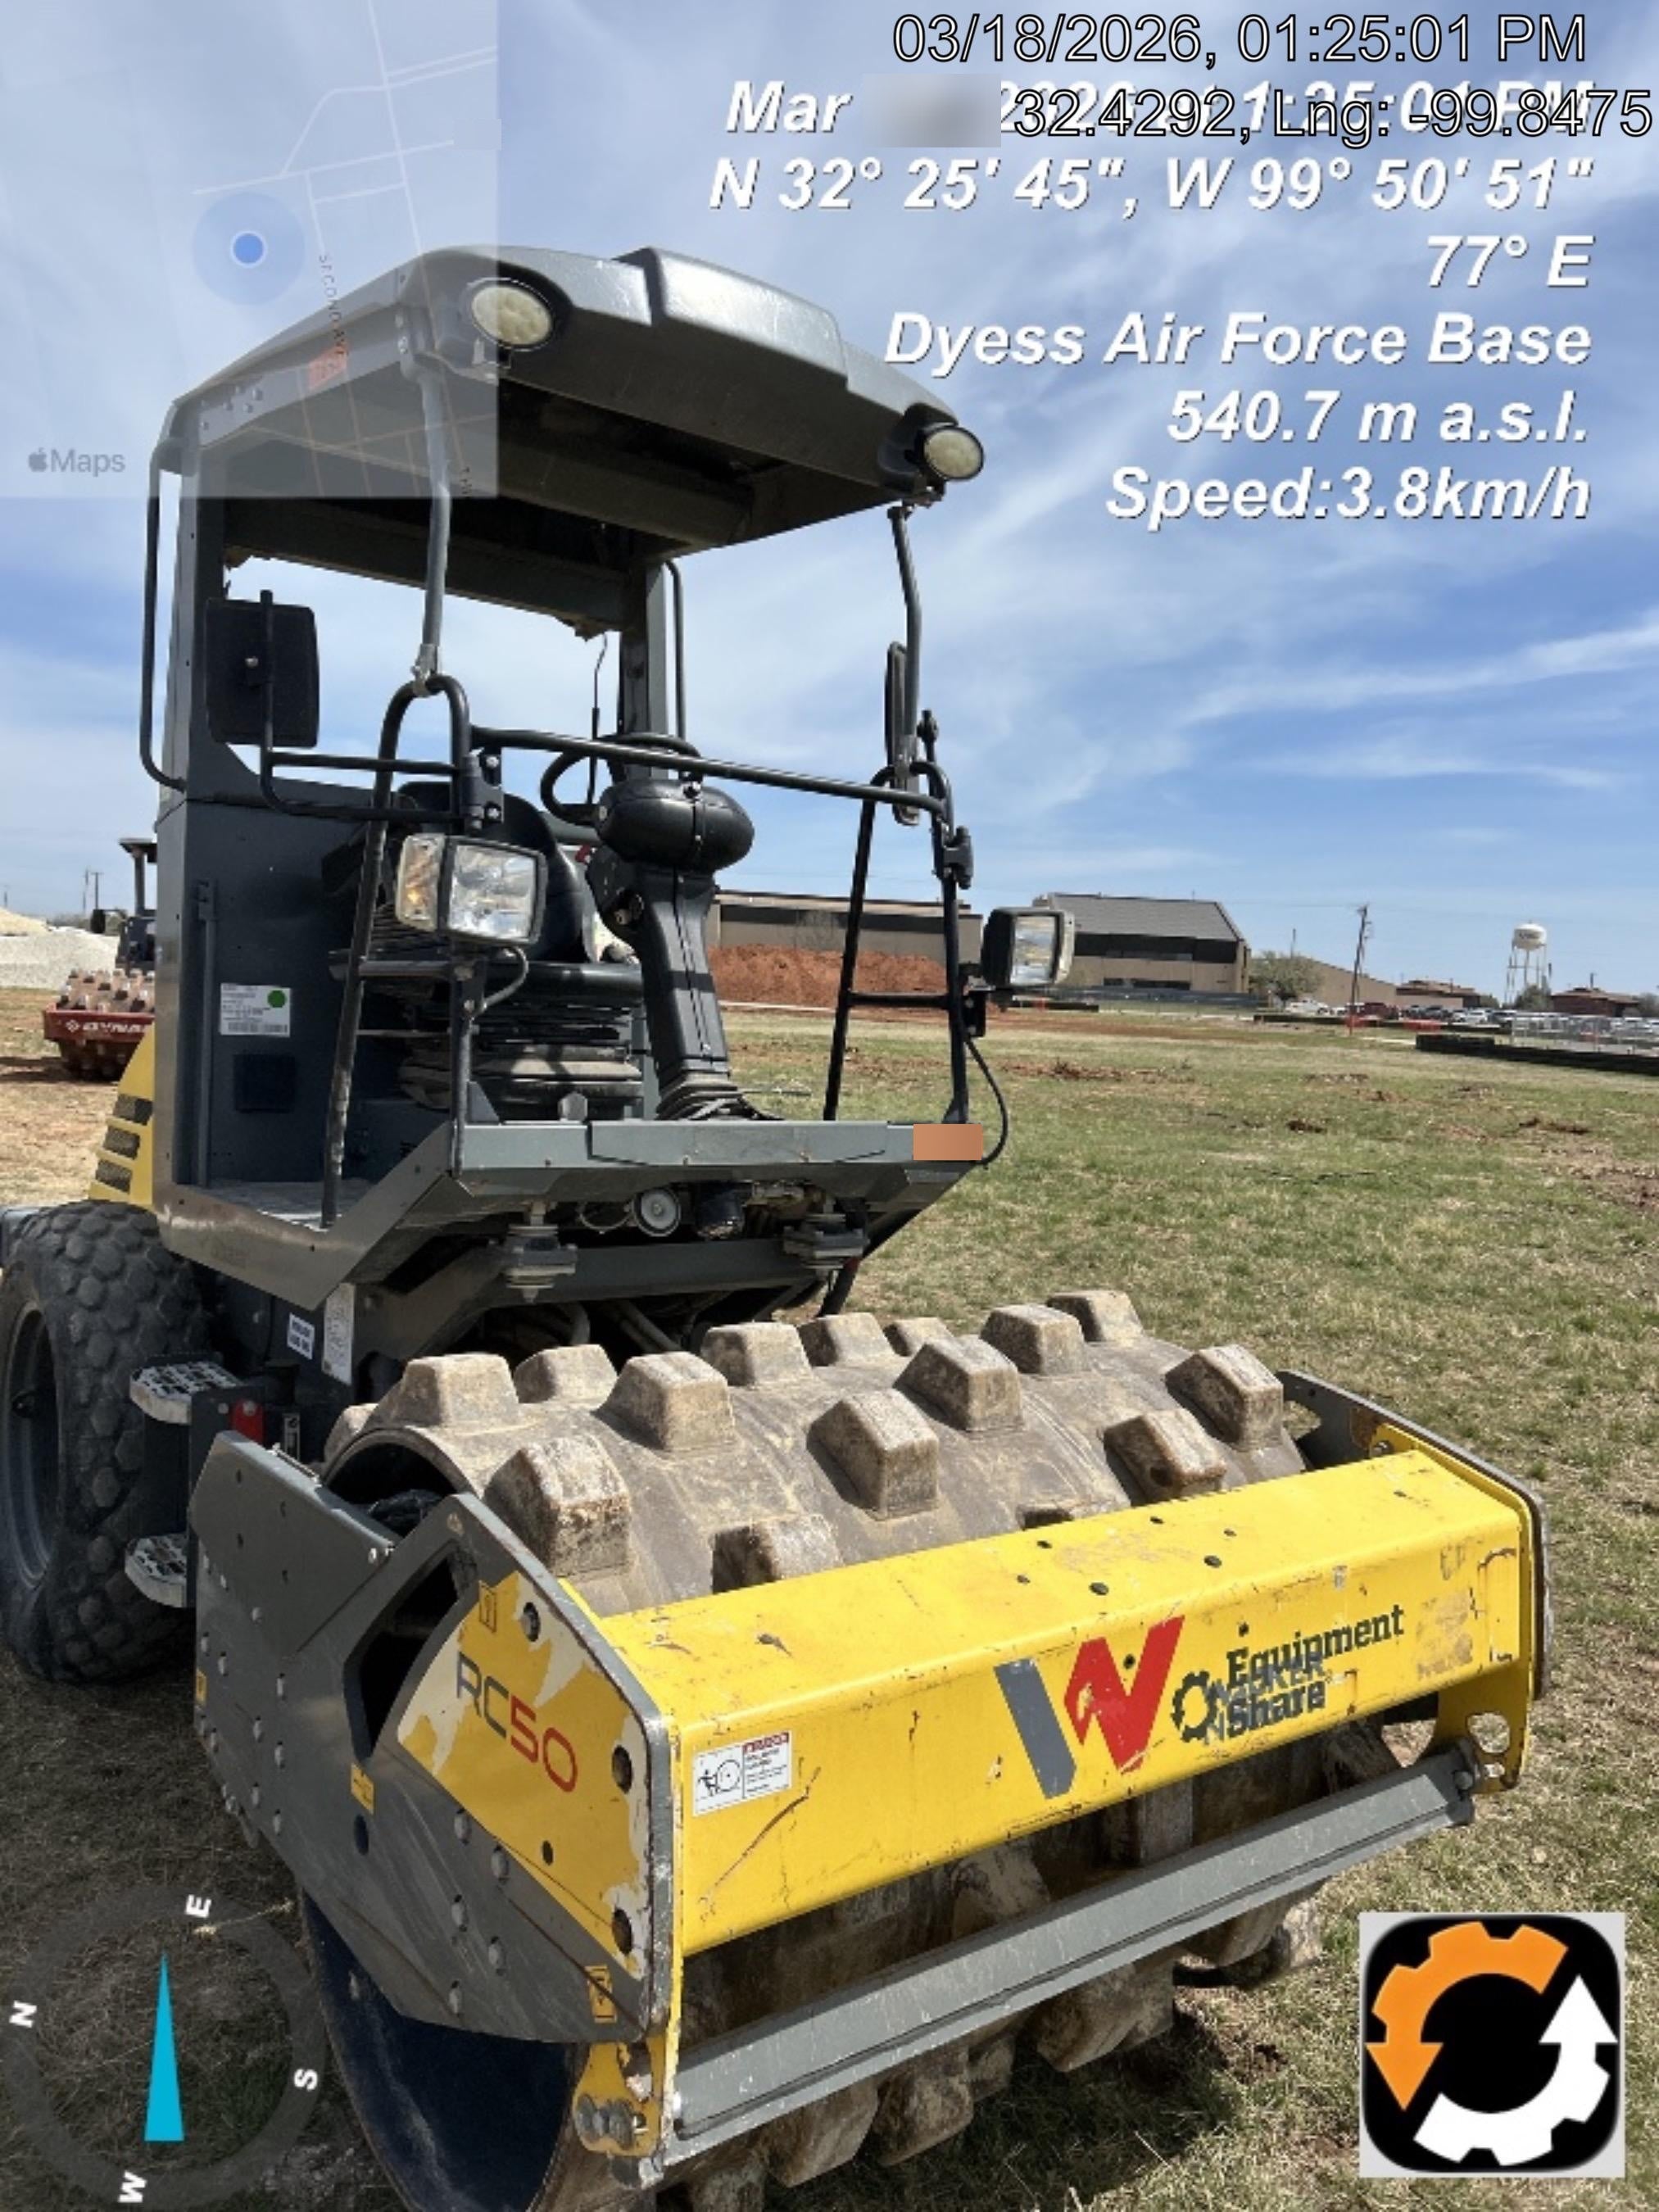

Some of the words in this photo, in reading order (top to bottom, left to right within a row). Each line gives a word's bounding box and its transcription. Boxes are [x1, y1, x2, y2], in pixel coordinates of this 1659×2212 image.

[1226, 1604, 1404, 1688] Equipment
[456, 1651, 578, 1793] RC50
[1229, 1680, 1326, 1738] Share
